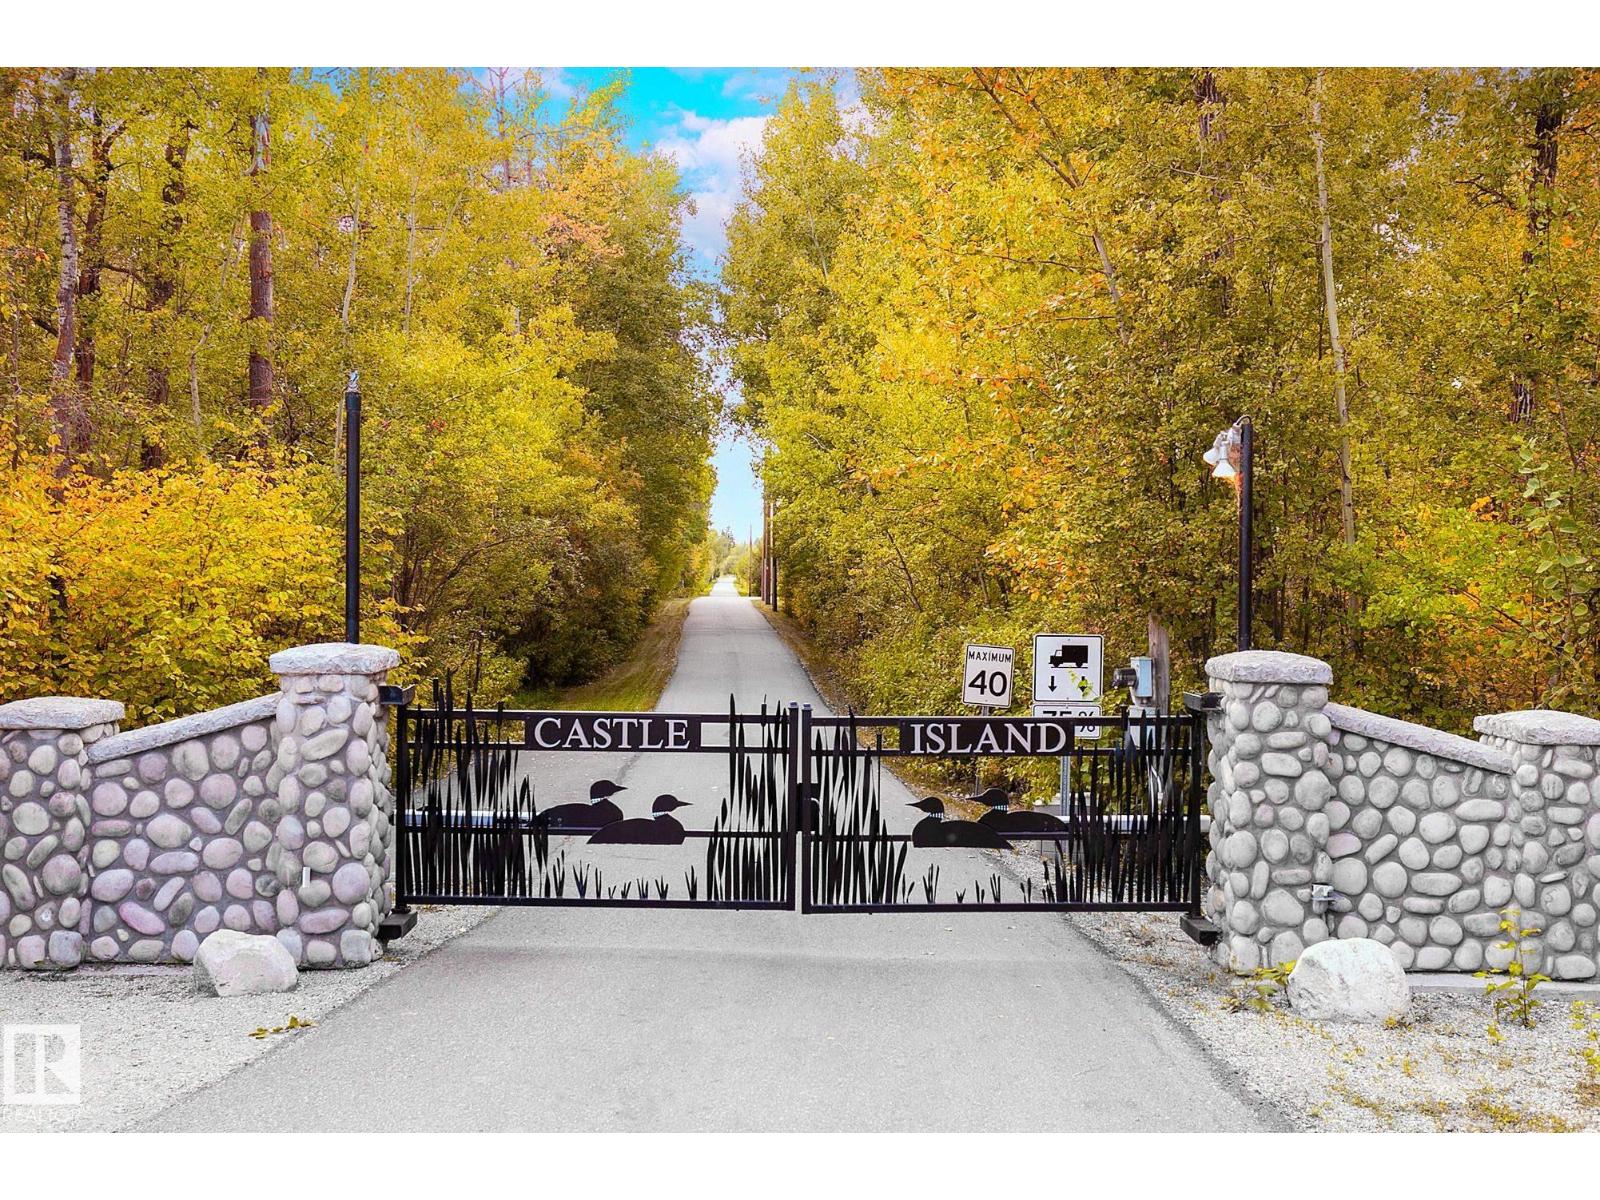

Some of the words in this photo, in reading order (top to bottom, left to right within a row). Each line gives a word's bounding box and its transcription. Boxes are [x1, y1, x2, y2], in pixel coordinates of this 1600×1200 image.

[968, 650, 1012, 663] MAXIMUM
[968, 669, 1008, 697] 40
[534, 717, 691, 749] CASTLE
[910, 722, 1067, 754] ISLAND
